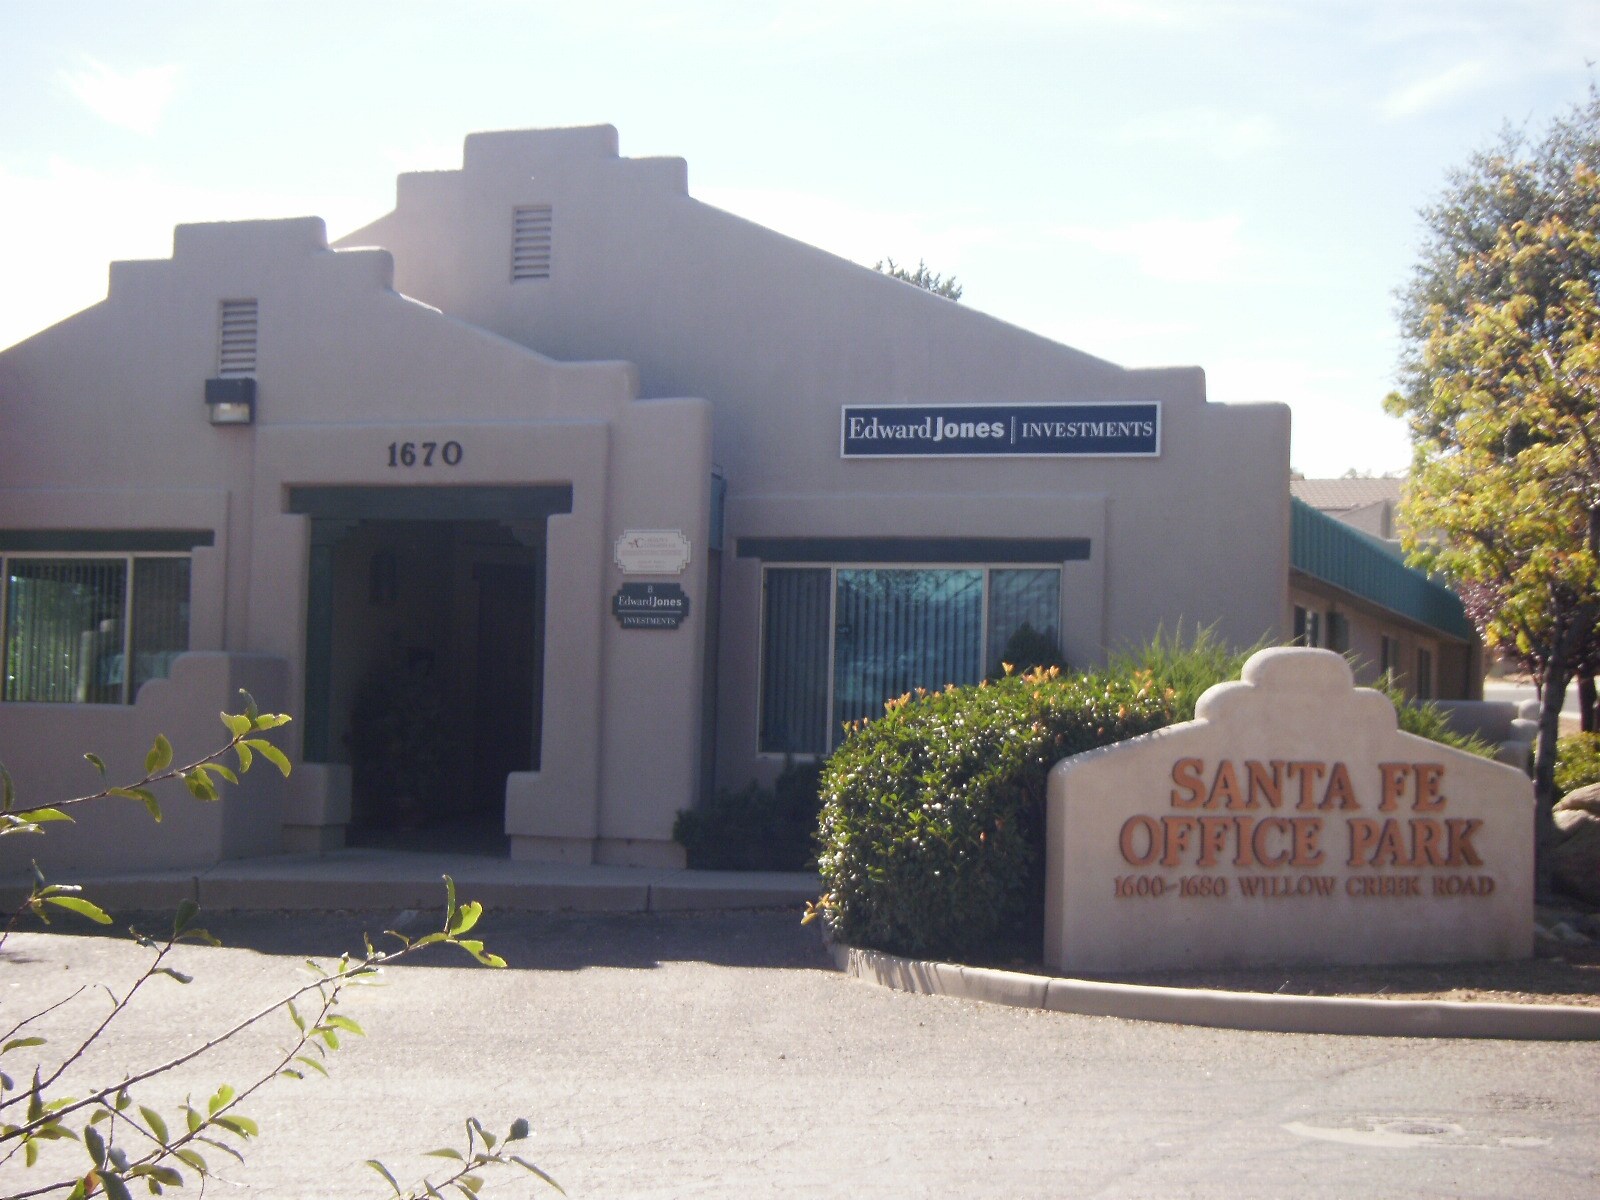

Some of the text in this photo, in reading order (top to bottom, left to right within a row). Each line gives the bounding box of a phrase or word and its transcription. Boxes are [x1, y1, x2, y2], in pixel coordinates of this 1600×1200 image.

[1021, 420, 1154, 438] INVESTMENTS
[387, 440, 463, 468] 1670
[623, 616, 676, 625] INVESTMENTS
[1170, 757, 1448, 813] SANTA FE
[1118, 814, 1484, 868] OFFICE PARK
[1113, 874, 1496, 899] 1600-1680 WILLOW CREEK ROAD
